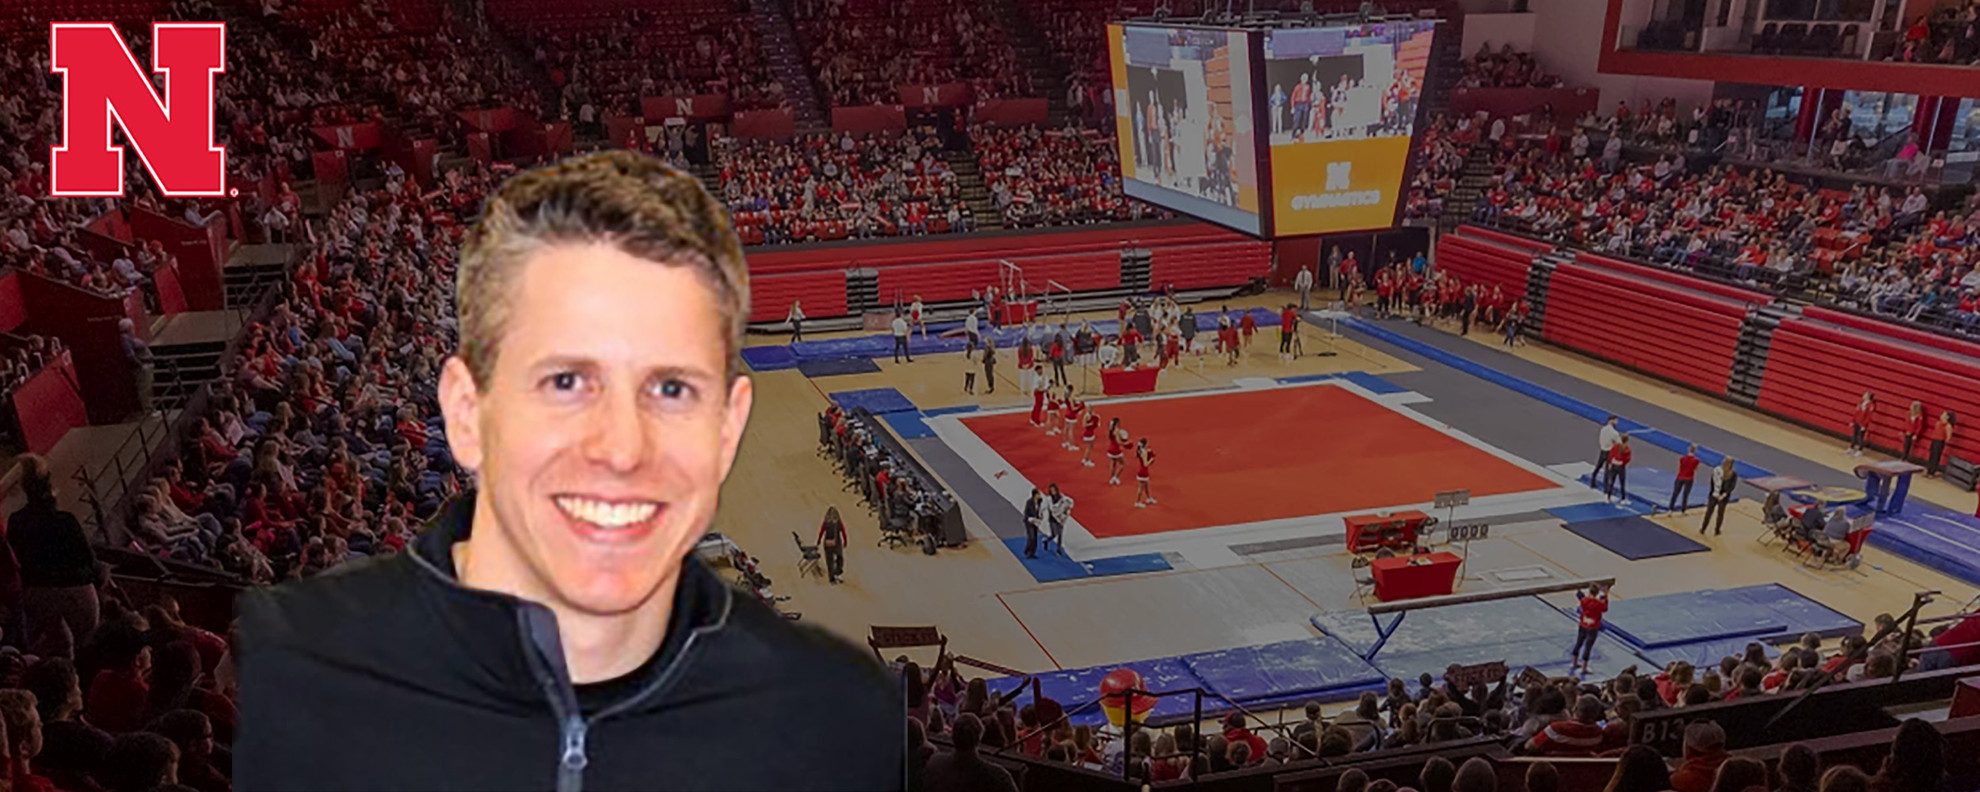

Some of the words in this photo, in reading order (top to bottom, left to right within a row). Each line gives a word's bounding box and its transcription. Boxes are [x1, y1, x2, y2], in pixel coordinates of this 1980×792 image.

[922, 86, 941, 105] N
[675, 98, 694, 116] N
[336, 127, 355, 148] N
